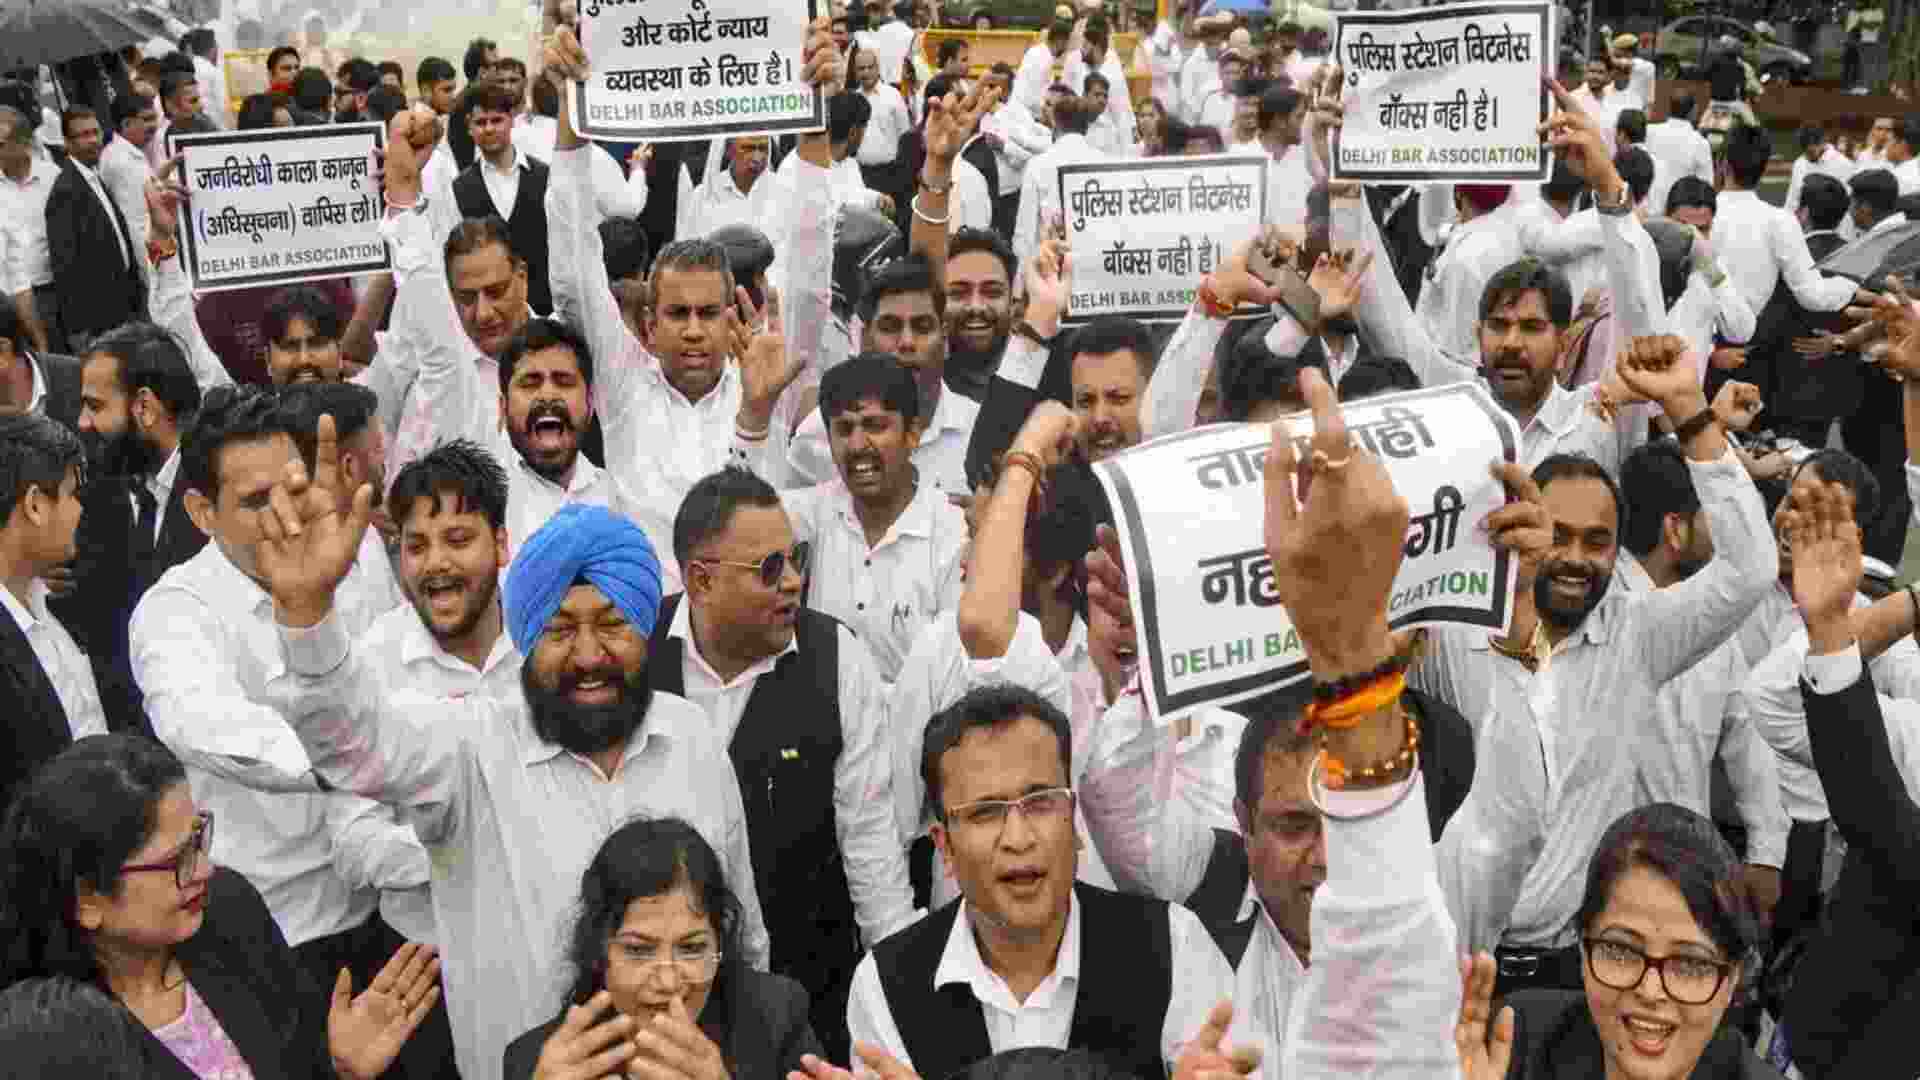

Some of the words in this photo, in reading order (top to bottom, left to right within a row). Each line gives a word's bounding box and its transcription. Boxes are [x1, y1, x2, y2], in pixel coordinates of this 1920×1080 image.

[667, 13, 712, 44] कोर्ट
[717, 17, 769, 39] न्याय
[605, 66, 683, 92] व्यवस्था
[688, 57, 712, 87] के
[718, 53, 760, 87] लिए
[1348, 32, 1397, 86] पुलिस
[1400, 31, 1460, 70] स्टेशन
[1464, 24, 1531, 64] विटनेस
[590, 104, 644, 121] DELHI
[650, 103, 686, 120] BAR
[691, 95, 810, 117] ASSOCIATION
[1379, 93, 1428, 129] बॉक्स
[1433, 88, 1468, 131] नही
[195, 153, 273, 189] जनविरोधी
[277, 160, 317, 184] काला
[320, 157, 368, 190] कानून
[1342, 148, 1385, 162] DELHI
[1391, 147, 1425, 162] BAR
[1426, 146, 1537, 162] ASSOCIATION
[199, 202, 296, 245] (अधिसूचना)
[302, 196, 346, 227] वापिस
[1071, 180, 1122, 232] पुलिस
[1127, 176, 1185, 216] स्टेशन
[1188, 172, 1252, 212] विटनेस
[200, 256, 245, 274] DELHI
[250, 252, 280, 270] BAR
[285, 244, 383, 265] ASSOCIATION
[1102, 240, 1153, 276] बॉक्स
[1070, 291, 1115, 309] DELHI
[1119, 290, 1151, 305] BAR
[1170, 638, 1253, 678] DELHI
[1264, 628, 1301, 657] BA
[1390, 572, 1488, 612] CIATION
